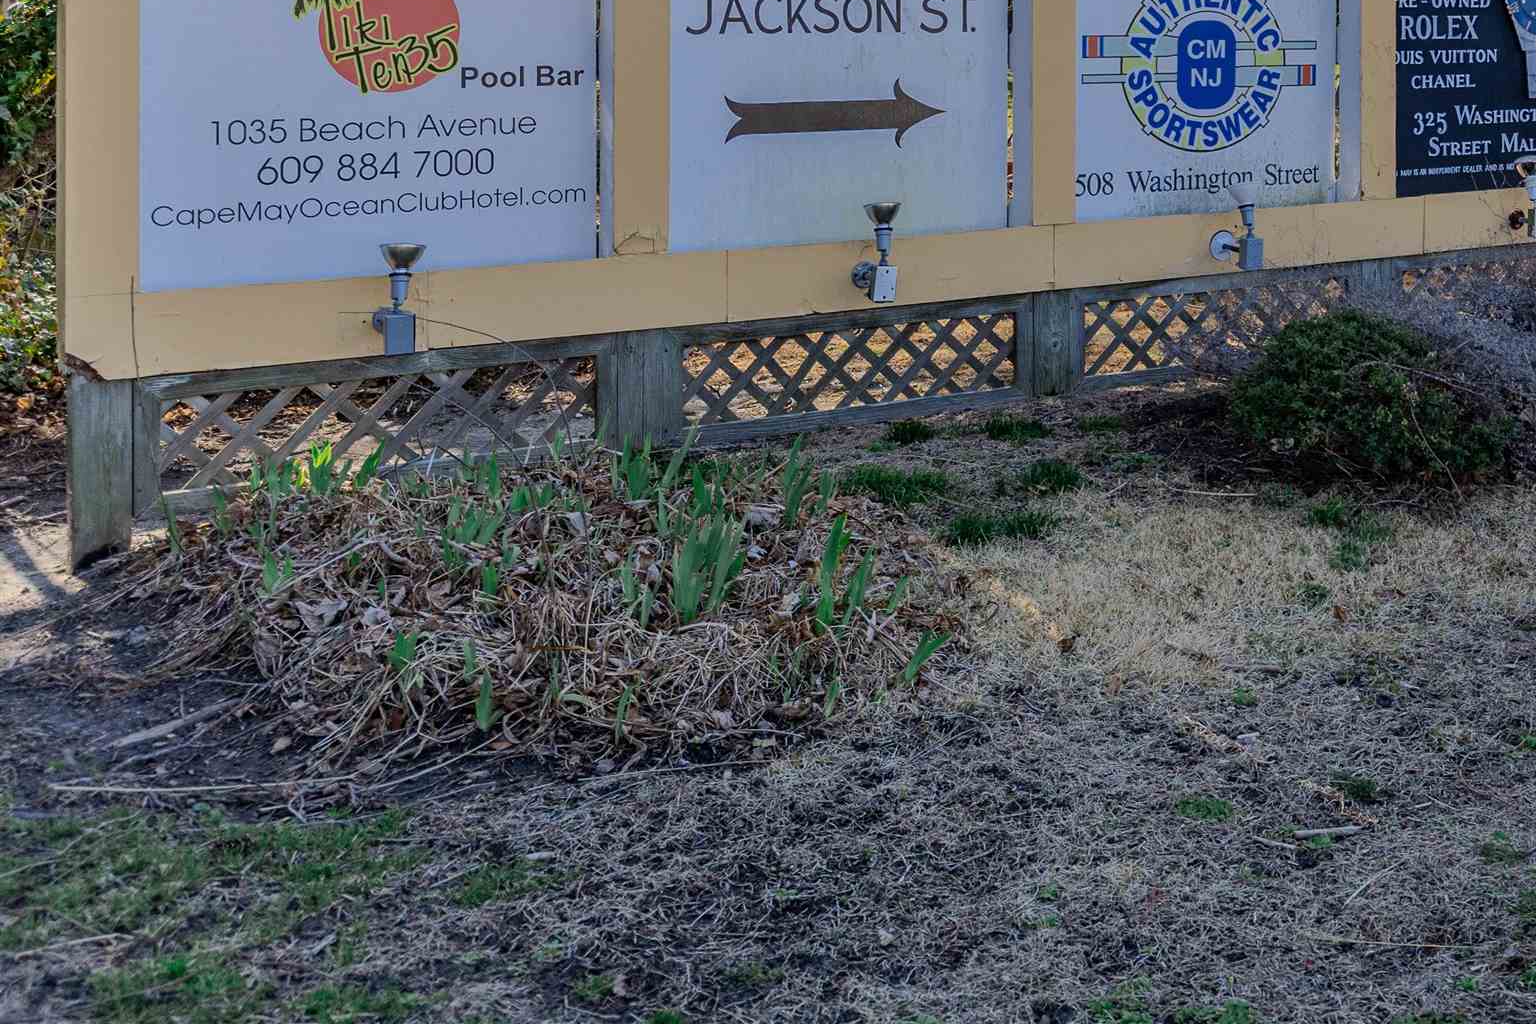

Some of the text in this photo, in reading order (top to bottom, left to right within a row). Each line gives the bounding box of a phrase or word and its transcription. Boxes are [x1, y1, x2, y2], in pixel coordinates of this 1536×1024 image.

[1400, 15, 1479, 40] ROLEX
[1187, 39, 1227, 59] CM
[1429, 49, 1498, 65] VUITTON
[460, 65, 584, 89] Pool Bar
[1190, 68, 1222, 88] NJ
[1411, 74, 1476, 89] CHANEL
[1128, 68, 1281, 147] SPORTSWEAR
[211, 113, 536, 145] 1035 Beach Avenue
[1413, 112, 1448, 135] 325
[257, 148, 494, 185] 609 884 7000
[1075, 163, 1320, 197] 508 Washington Street
[151, 186, 586, 230] CapeMayOceanClubHotel.com
